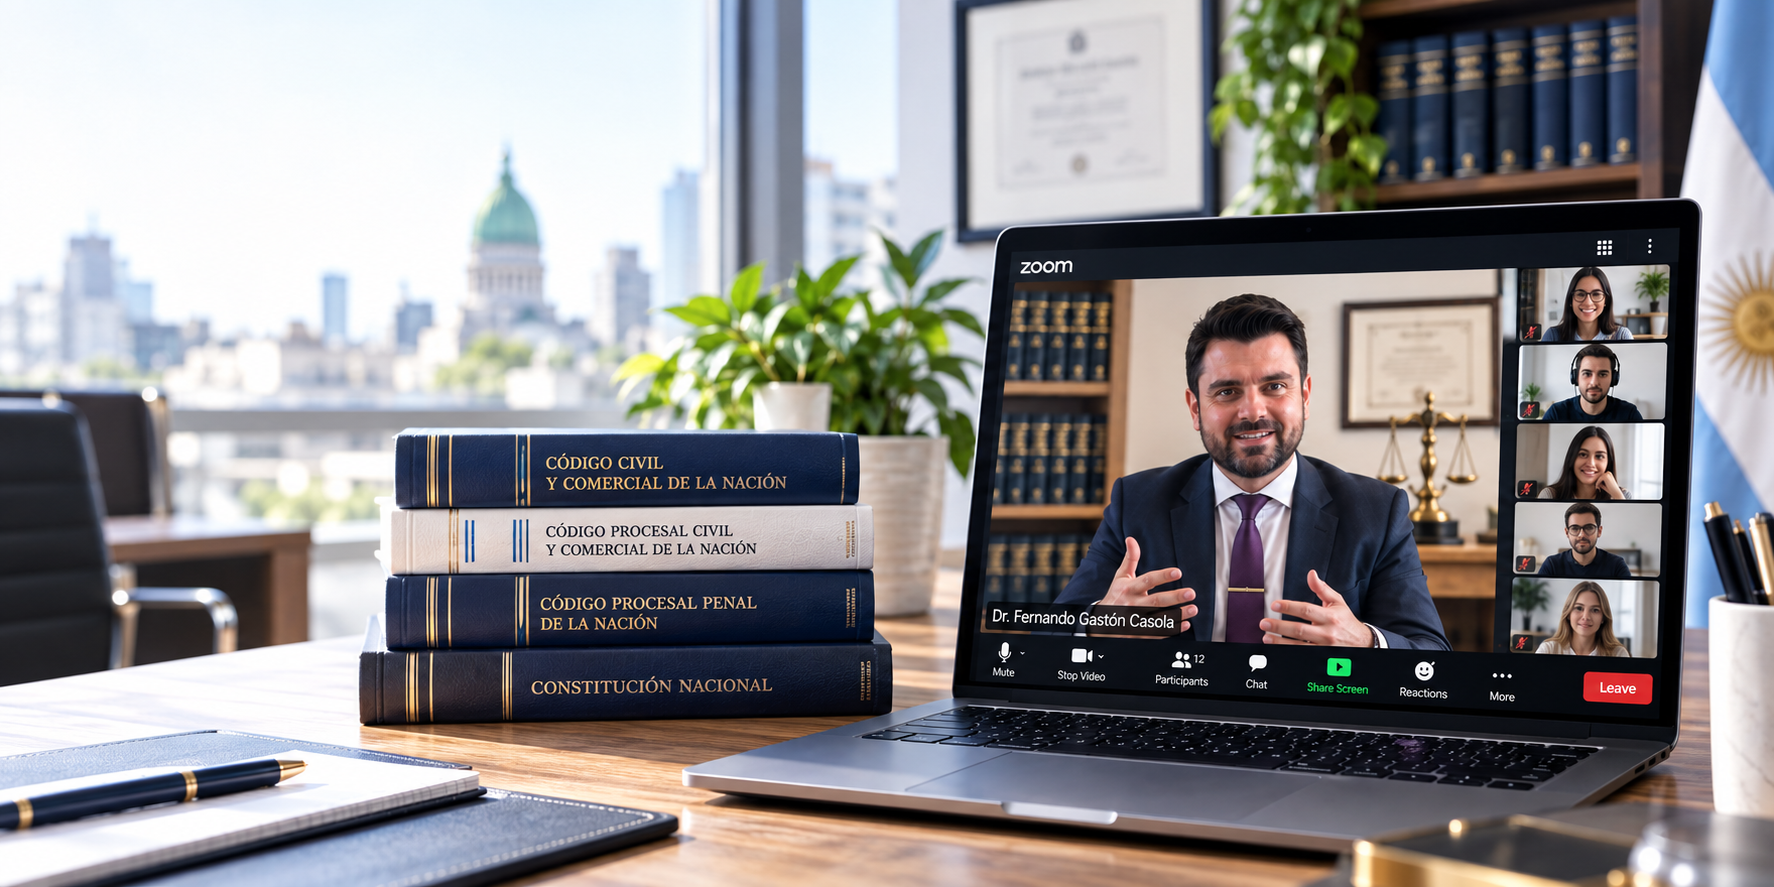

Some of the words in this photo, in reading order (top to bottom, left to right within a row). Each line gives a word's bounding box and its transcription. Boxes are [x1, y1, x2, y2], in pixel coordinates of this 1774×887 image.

[1020, 260, 1073, 274] zoom
[545, 453, 613, 470] CÓDIGO
[617, 456, 664, 470] CIVIL
[545, 477, 558, 491] Y
[562, 476, 663, 491] COMERCIAL
[667, 476, 691, 490] DE
[695, 476, 717, 490] LA
[722, 473, 787, 490] NACIÓN
[545, 522, 606, 538] CÓDIGO
[610, 524, 689, 538] PROCESAL
[692, 524, 734, 537] CIVIL
[545, 543, 556, 556] Y
[560, 543, 648, 556] COMERCIAL
[652, 543, 673, 556] DE
[676, 543, 696, 555] LA
[700, 540, 757, 555] NACIÓN
[540, 593, 607, 611] CÓDIGO
[611, 596, 698, 611] PROCESAL
[702, 595, 758, 610] PENAL
[540, 617, 563, 631] DE
[567, 617, 590, 631] LA
[594, 613, 658, 631] NACIÓN
[992, 608, 1010, 623] Dr.
[1014, 609, 1076, 626] Fernando
[1079, 612, 1126, 628] Gastón
[1129, 613, 1175, 629] Casola
[1193, 654, 1205, 664] 12
[992, 667, 1015, 677] Mute
[1057, 669, 1078, 683] Stop
[1079, 670, 1106, 682] Video
[530, 676, 672, 695] CONSTITUCIÓN
[679, 678, 773, 693] NACIONAL
[1155, 674, 1209, 688] Participants
[1245, 678, 1268, 690] Chat
[1307, 681, 1334, 693] Share
[1336, 683, 1369, 695] Screen
[1599, 681, 1637, 695] Leave
[1399, 686, 1448, 699] Reactions
[1489, 691, 1516, 702] More
